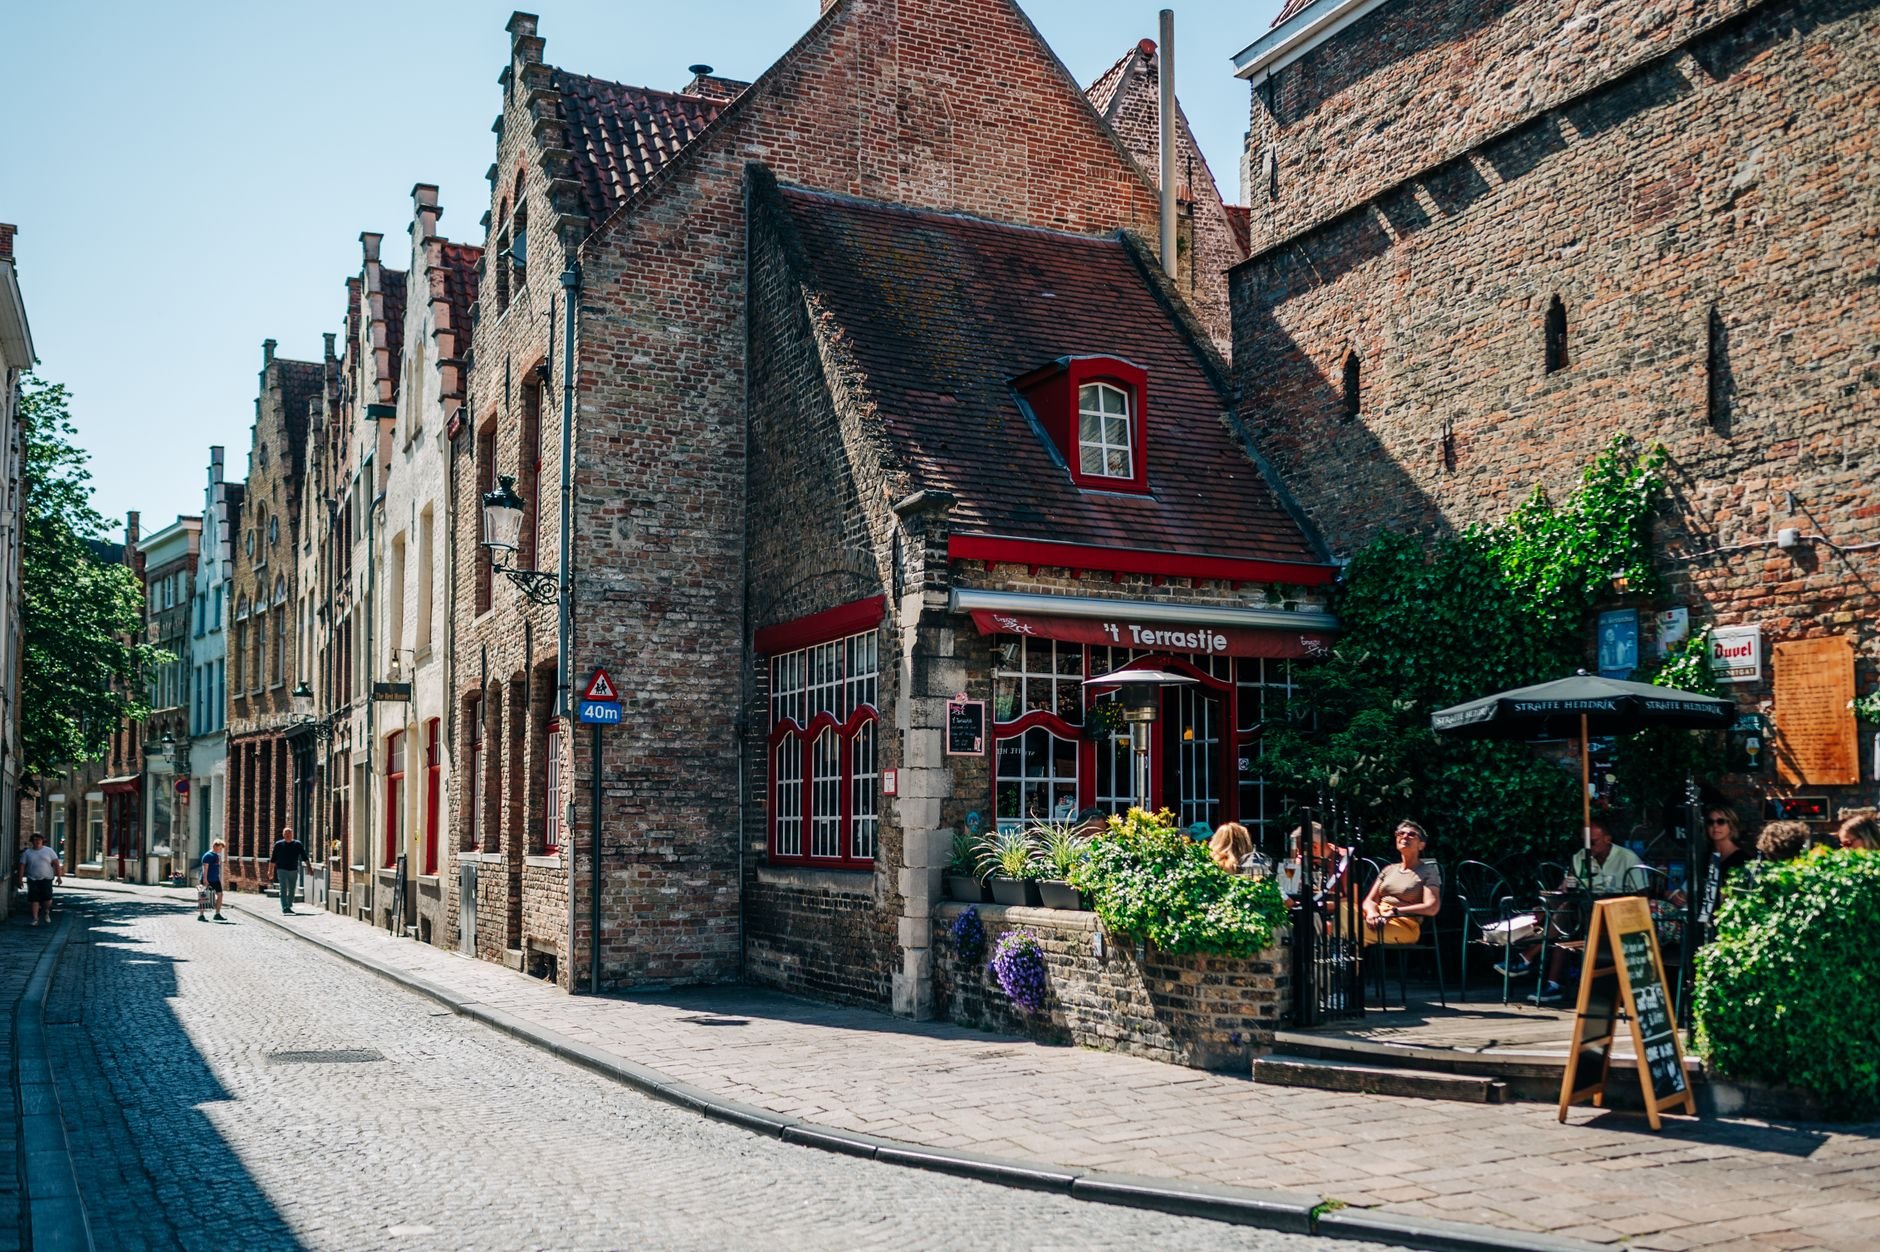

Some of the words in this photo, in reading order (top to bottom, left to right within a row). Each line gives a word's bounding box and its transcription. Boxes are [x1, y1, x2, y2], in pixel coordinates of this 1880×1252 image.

[1103, 623, 1119, 642] 't
[1128, 625, 1227, 654] Terrastje
[1714, 641, 1752, 659] Duvel
[584, 704, 618, 719] 40m
[1514, 702, 1560, 711] STRAFFE
[1564, 700, 1616, 711] HENDRIK
